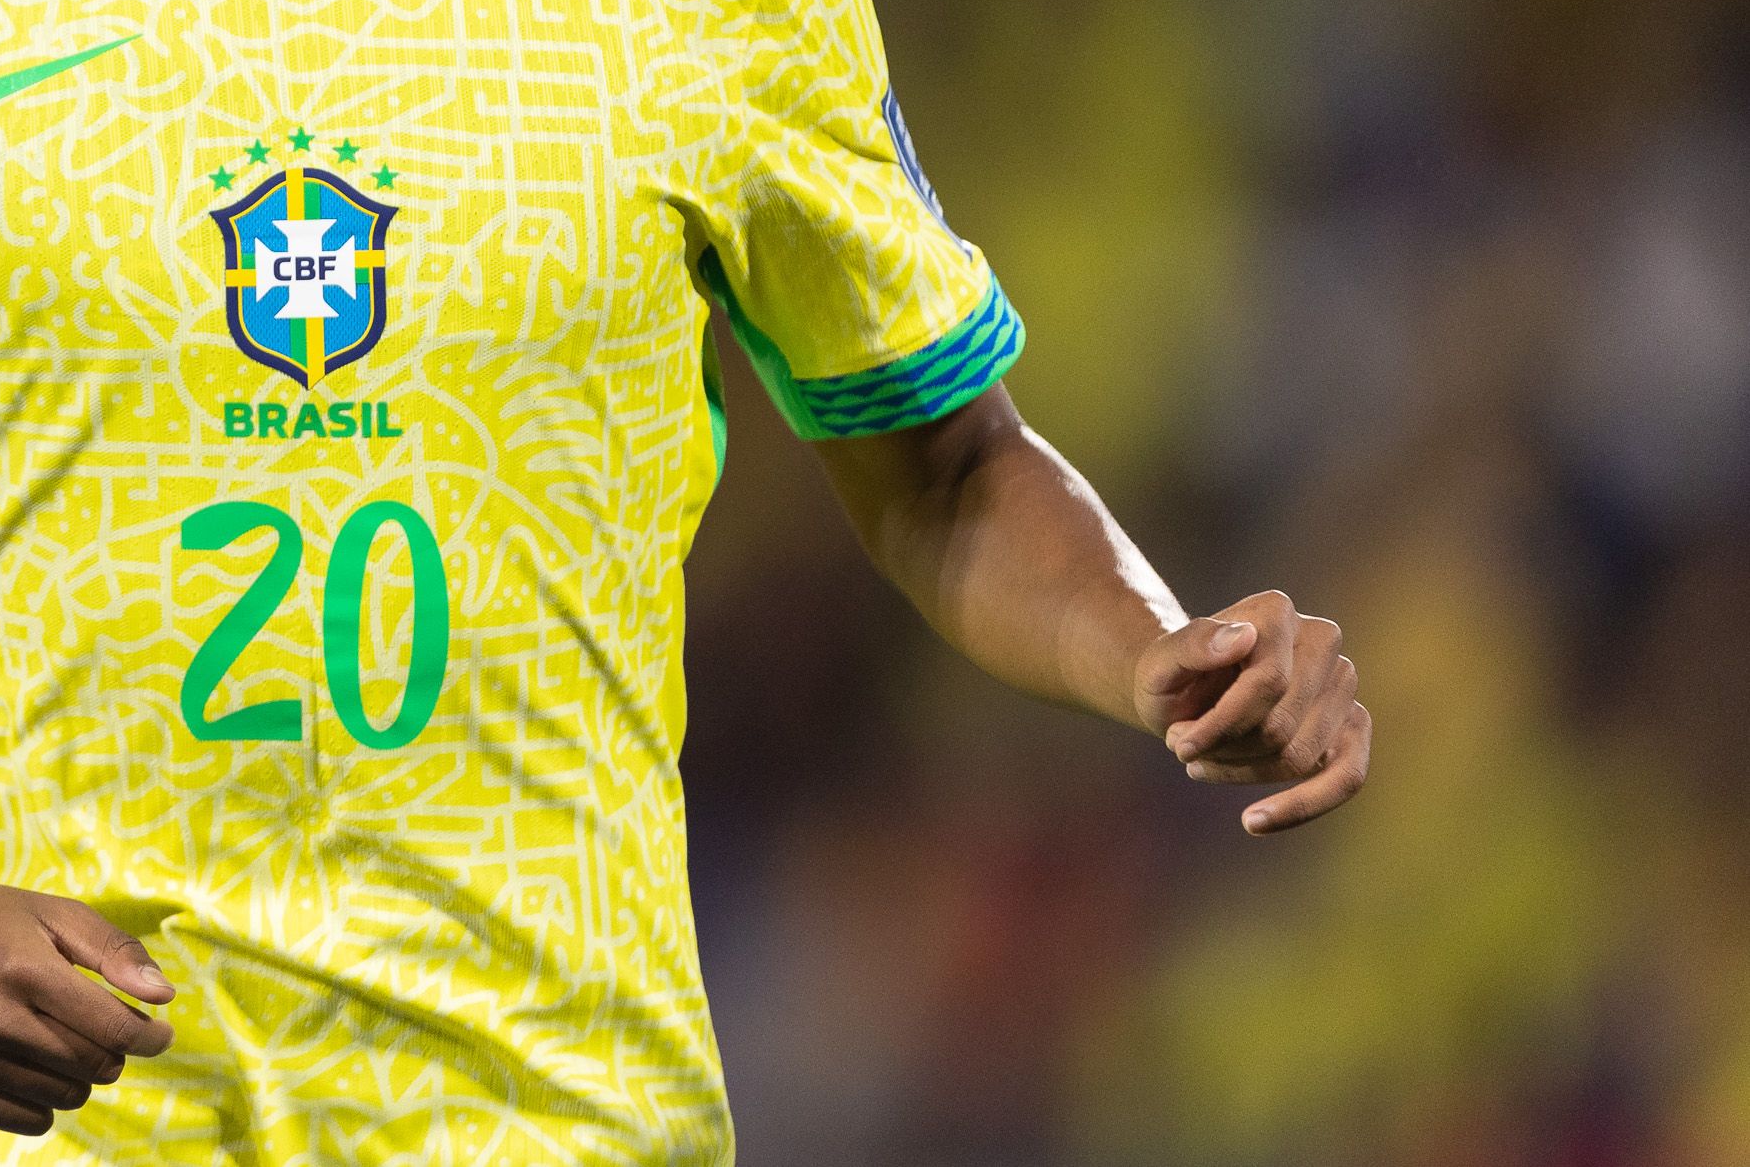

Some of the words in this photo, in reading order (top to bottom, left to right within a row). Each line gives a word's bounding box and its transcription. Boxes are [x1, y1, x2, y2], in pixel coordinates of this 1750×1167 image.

[273, 256, 337, 282] CBF
[223, 401, 404, 439] BRASIL
[180, 500, 450, 751] 20
